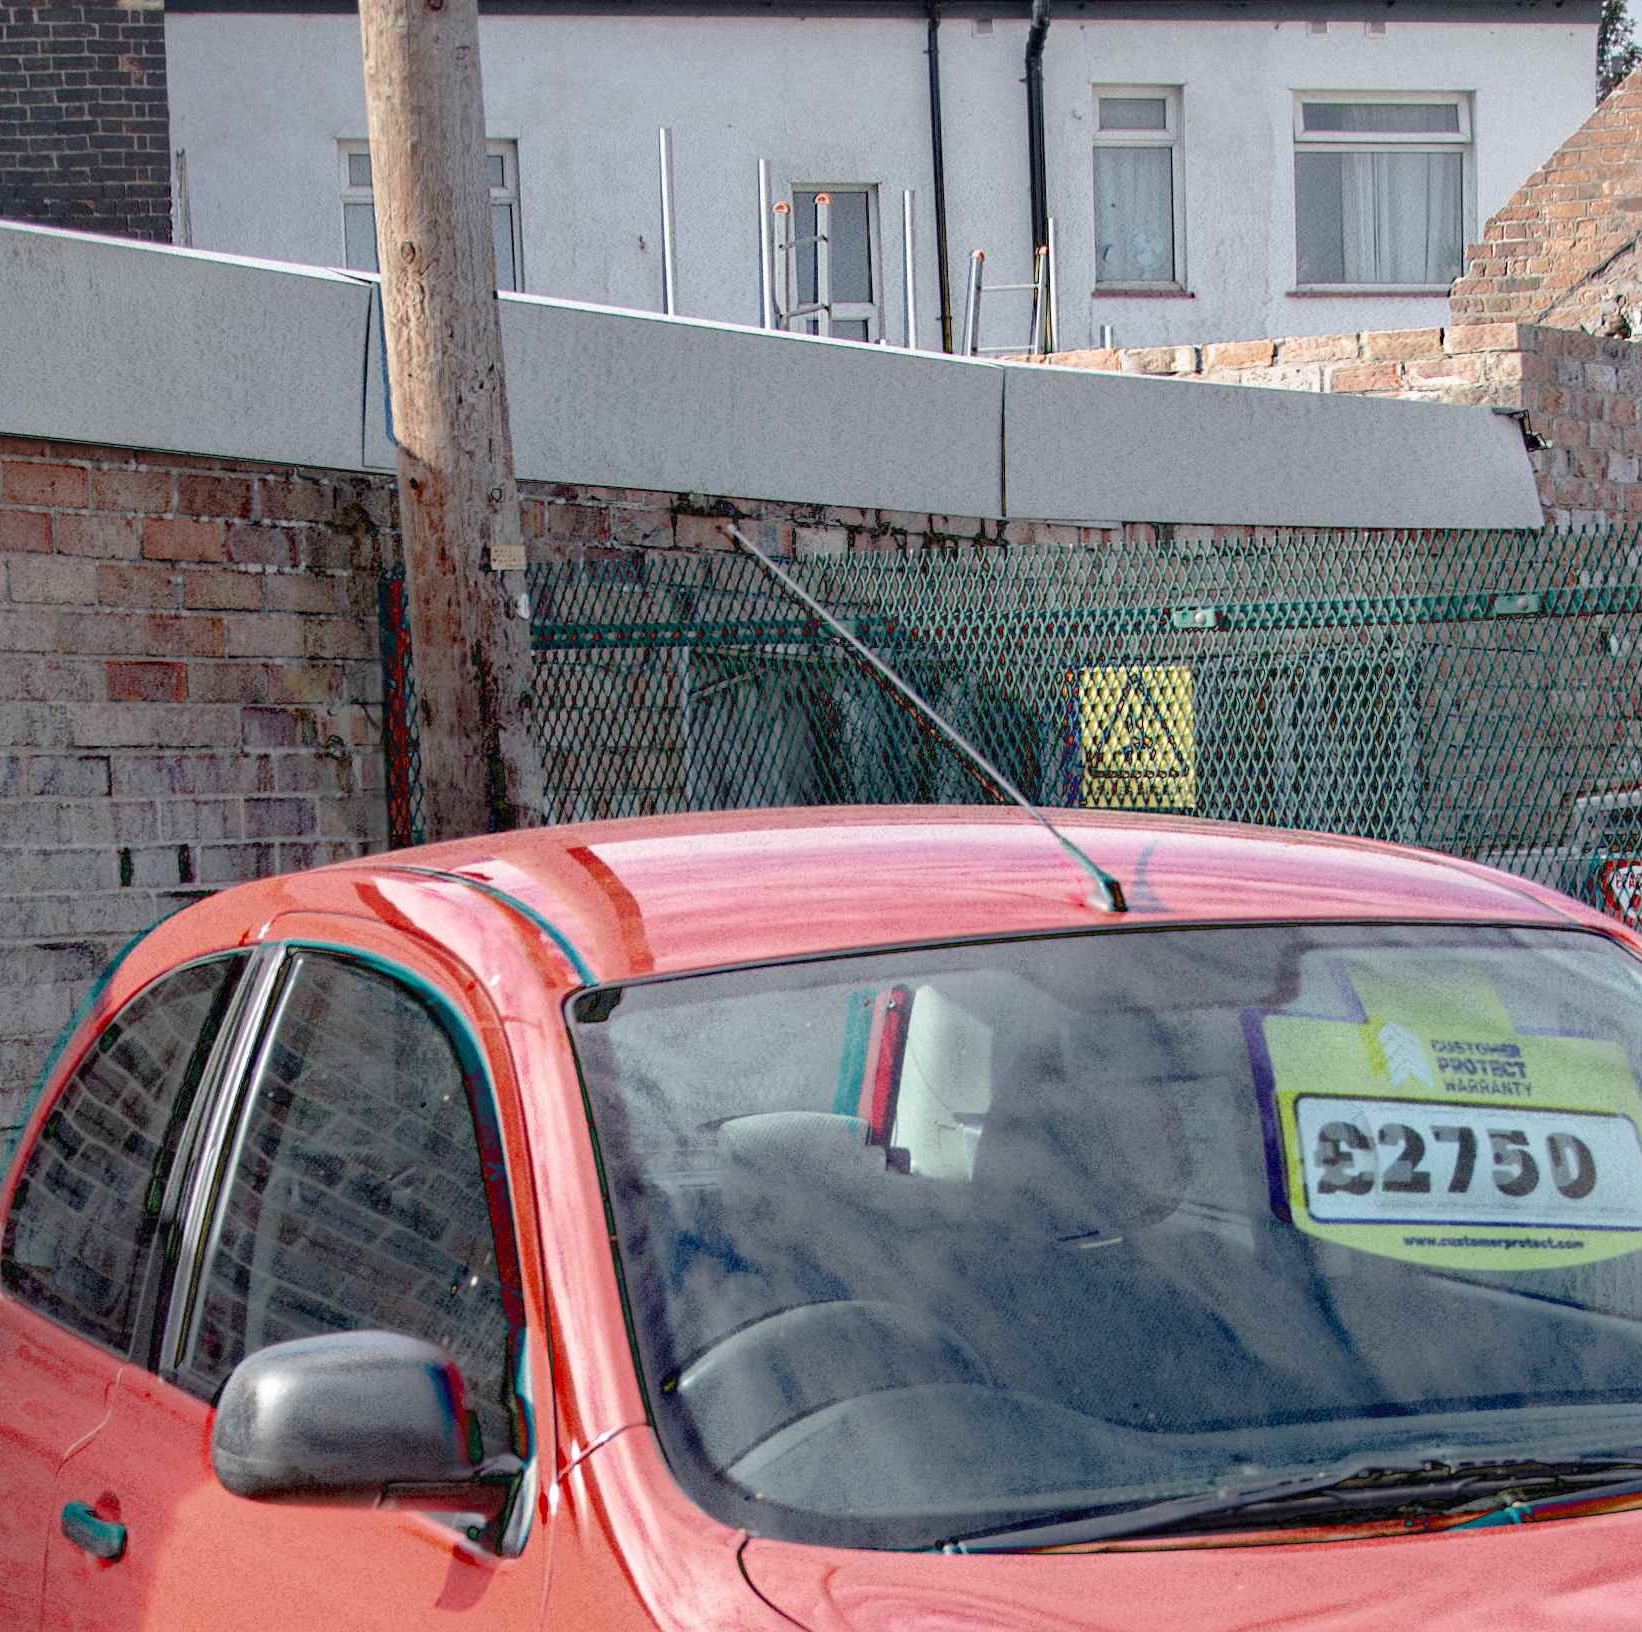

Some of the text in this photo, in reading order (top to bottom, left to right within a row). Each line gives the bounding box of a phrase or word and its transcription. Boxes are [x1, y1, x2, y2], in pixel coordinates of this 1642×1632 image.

[1436, 1056, 1527, 1079] PROTECT
[1443, 1079, 1533, 1097] WARRANTY
[1313, 1120, 1598, 1200] £2750
[1402, 1233, 1585, 1251] www.customerprotect.com
